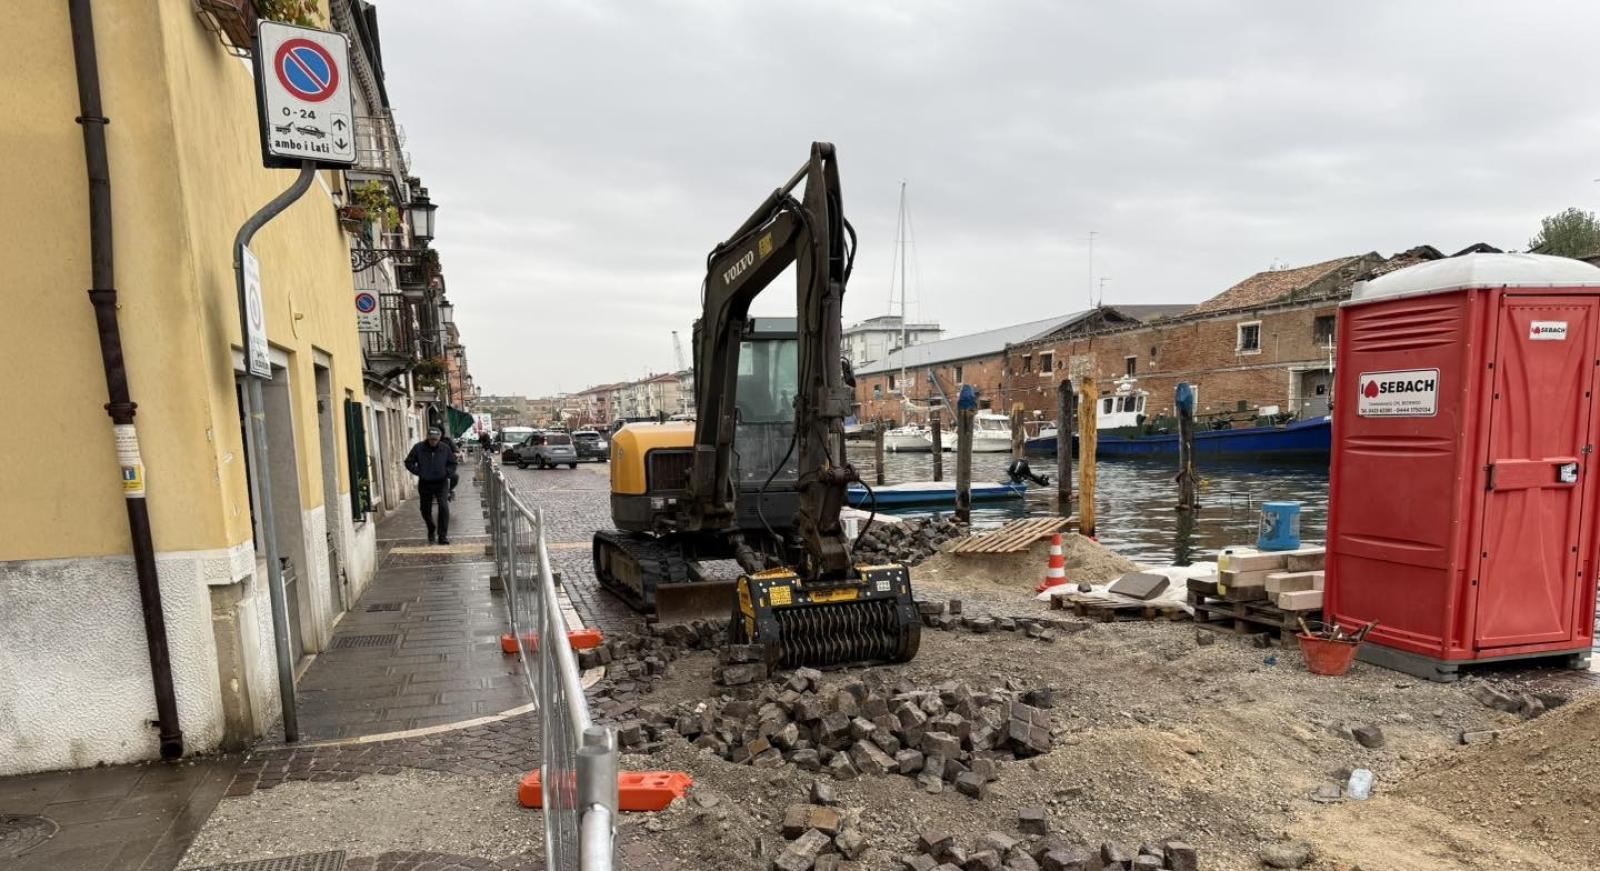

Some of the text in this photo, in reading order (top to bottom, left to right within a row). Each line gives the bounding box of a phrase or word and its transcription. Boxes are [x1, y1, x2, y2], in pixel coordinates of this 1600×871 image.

[275, 139, 330, 153] ambo i lati
[723, 250, 754, 285] VOLVO
[1380, 379, 1435, 394] SEBACH
